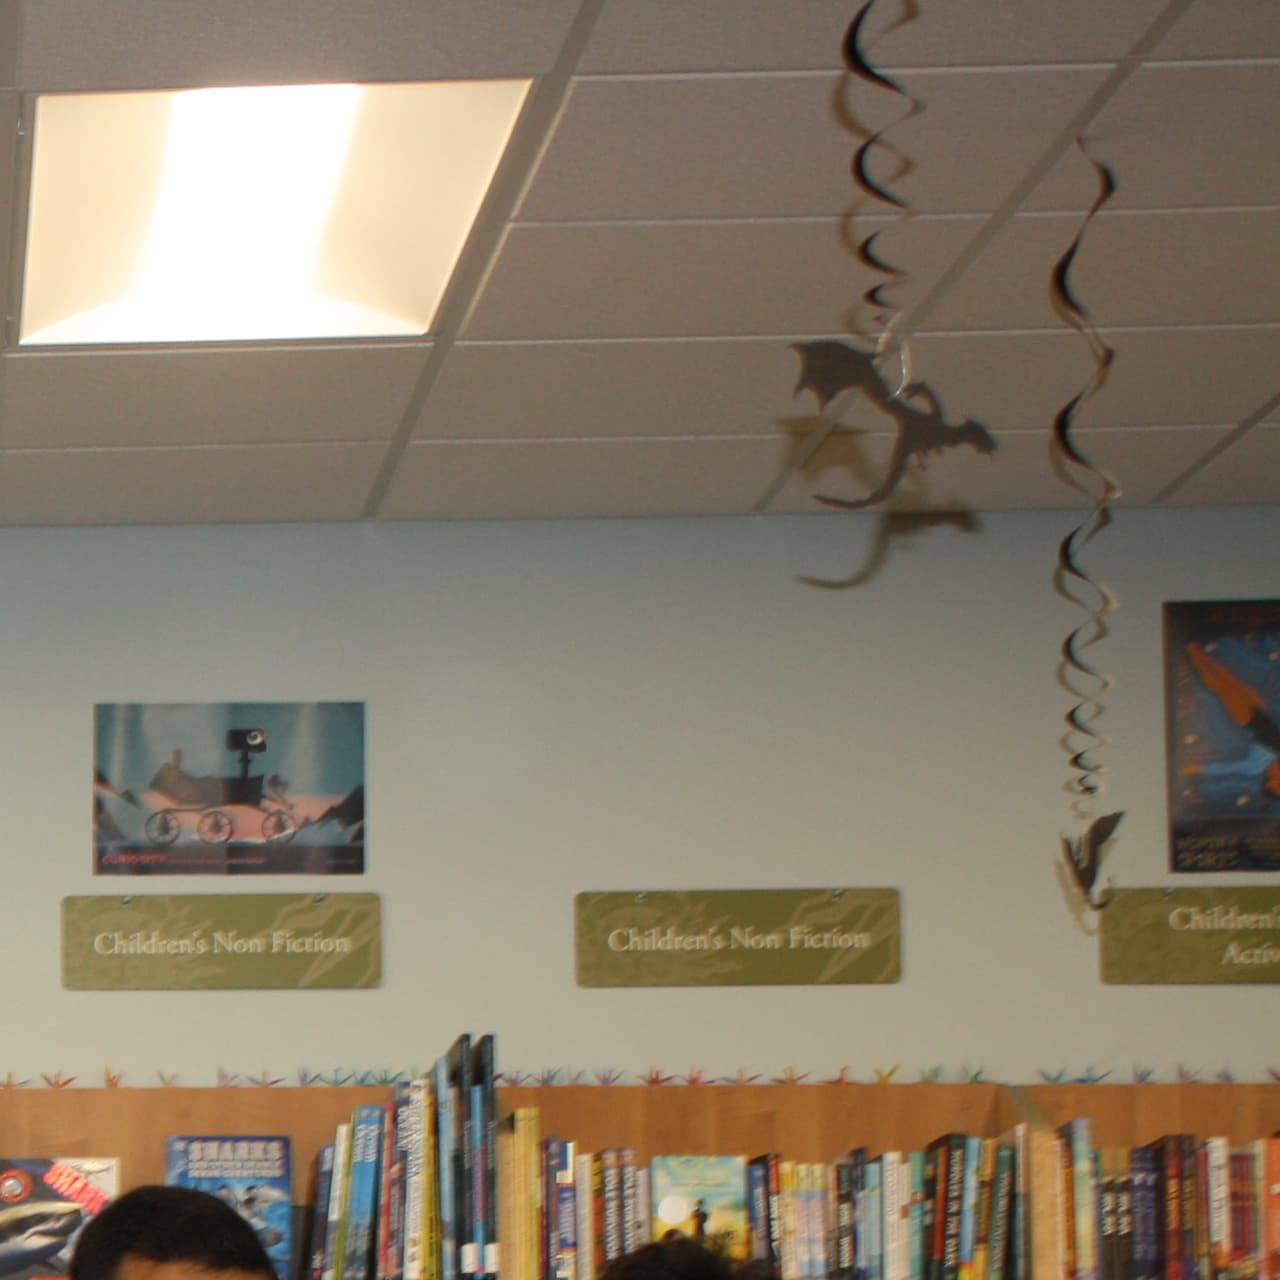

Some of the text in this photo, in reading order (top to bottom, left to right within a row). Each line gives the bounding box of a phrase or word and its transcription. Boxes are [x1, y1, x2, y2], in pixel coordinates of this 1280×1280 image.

[94, 929, 352, 955] Children's Non Fiction
[608, 925, 872, 952] Children's Non Fiction
